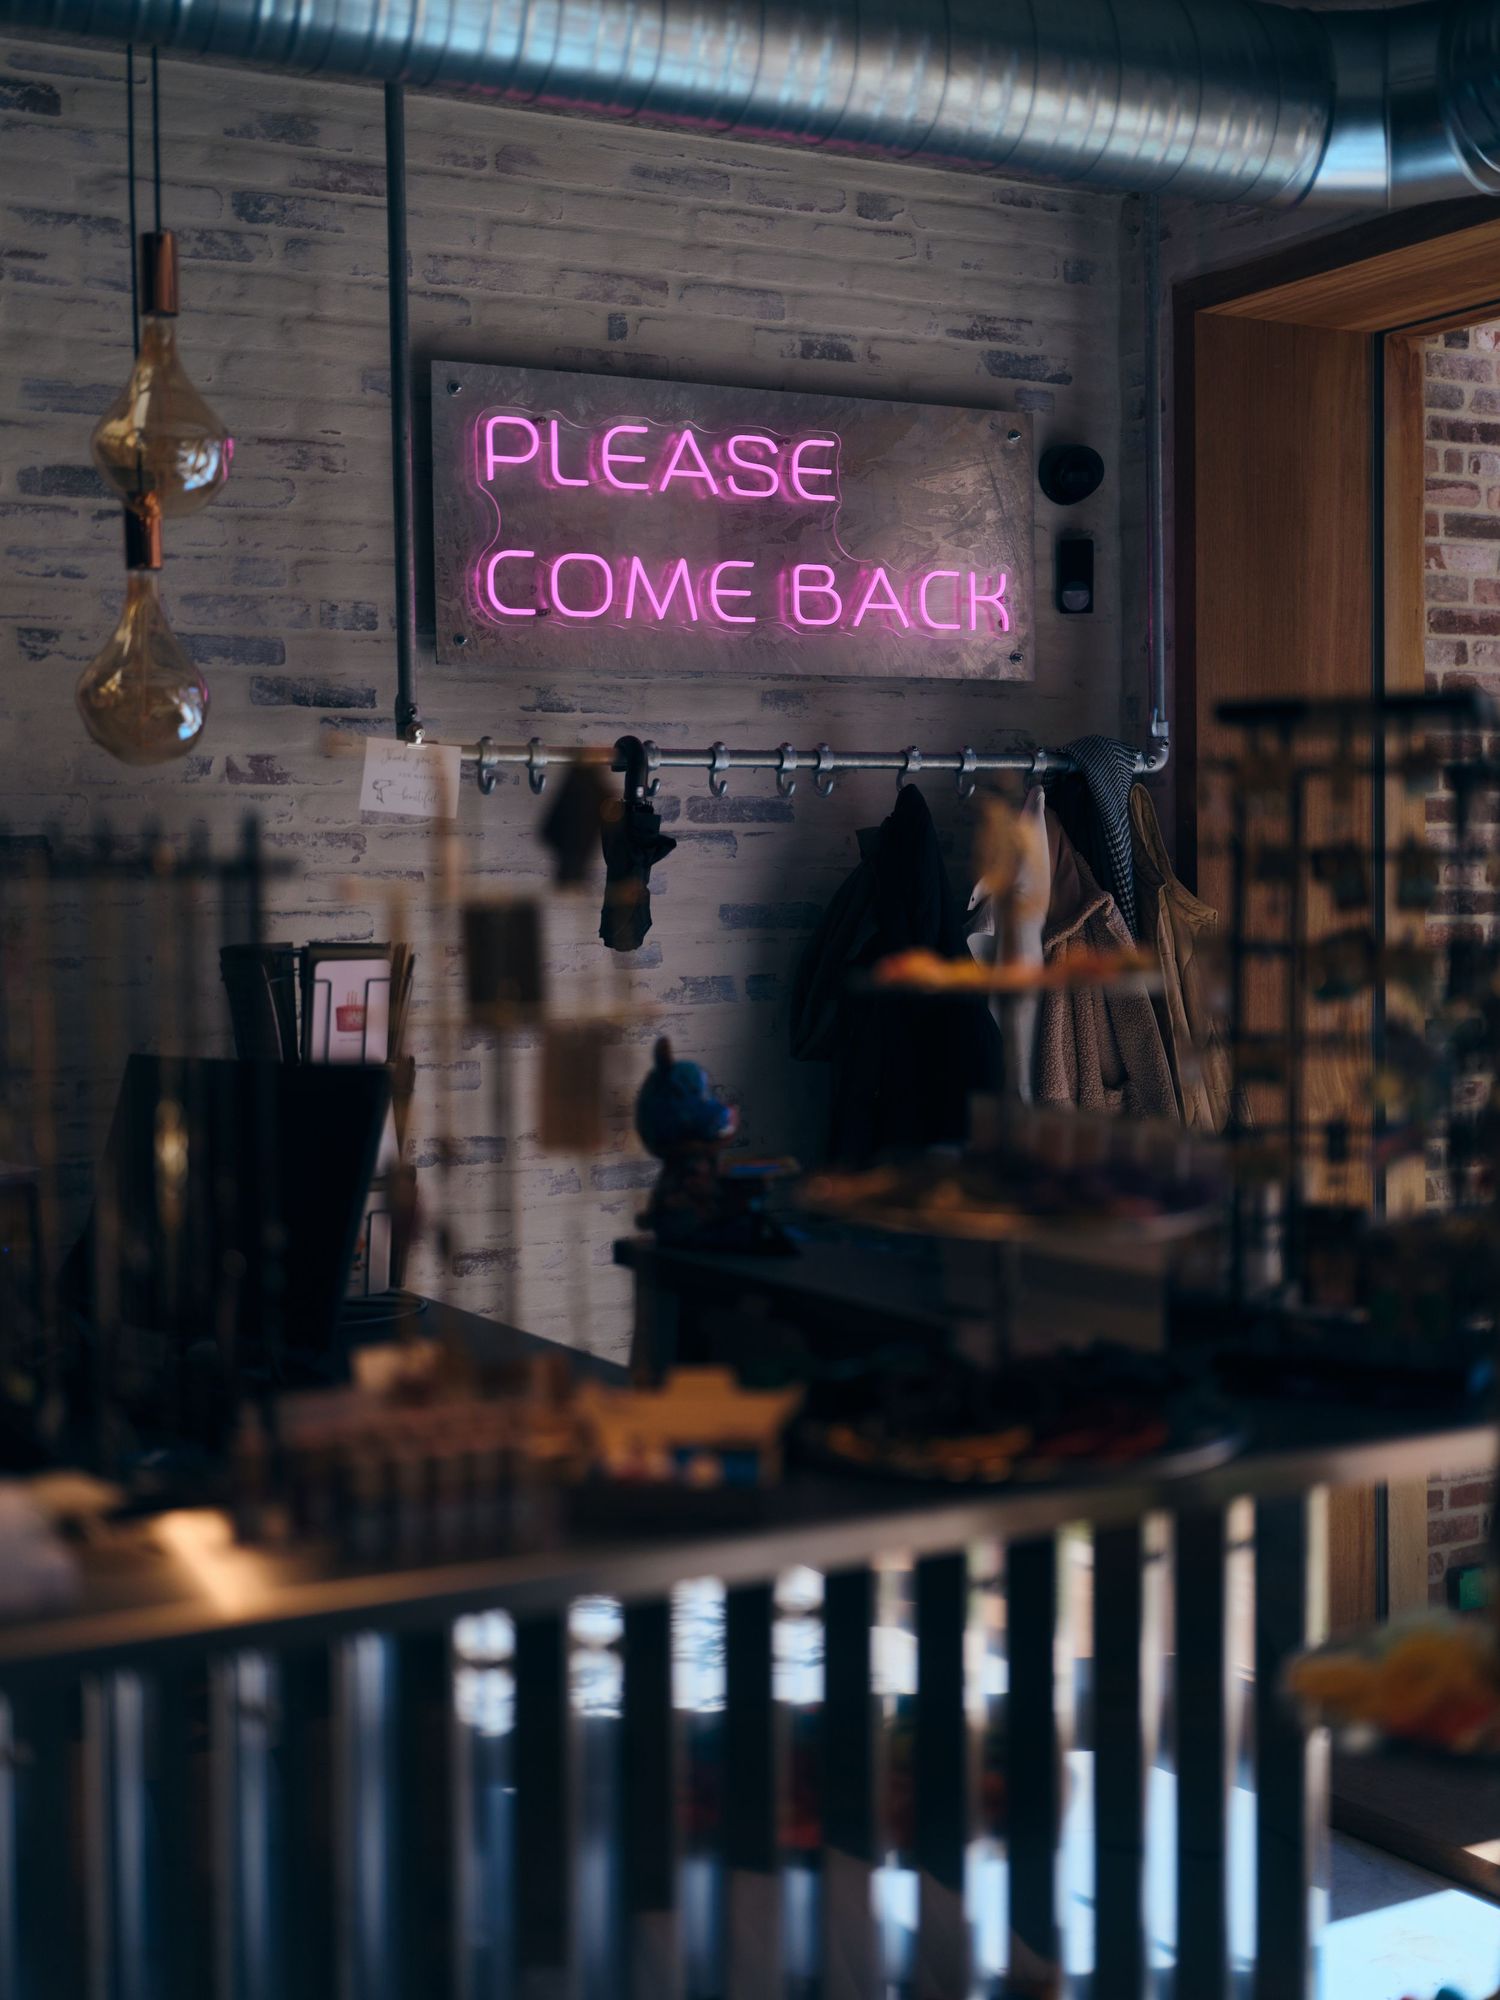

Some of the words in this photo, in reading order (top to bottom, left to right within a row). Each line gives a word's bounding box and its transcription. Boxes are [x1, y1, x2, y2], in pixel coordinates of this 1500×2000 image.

[485, 415, 836, 501] PLEASE
[486, 549, 756, 624] COME
[792, 563, 1010, 632] BACK
